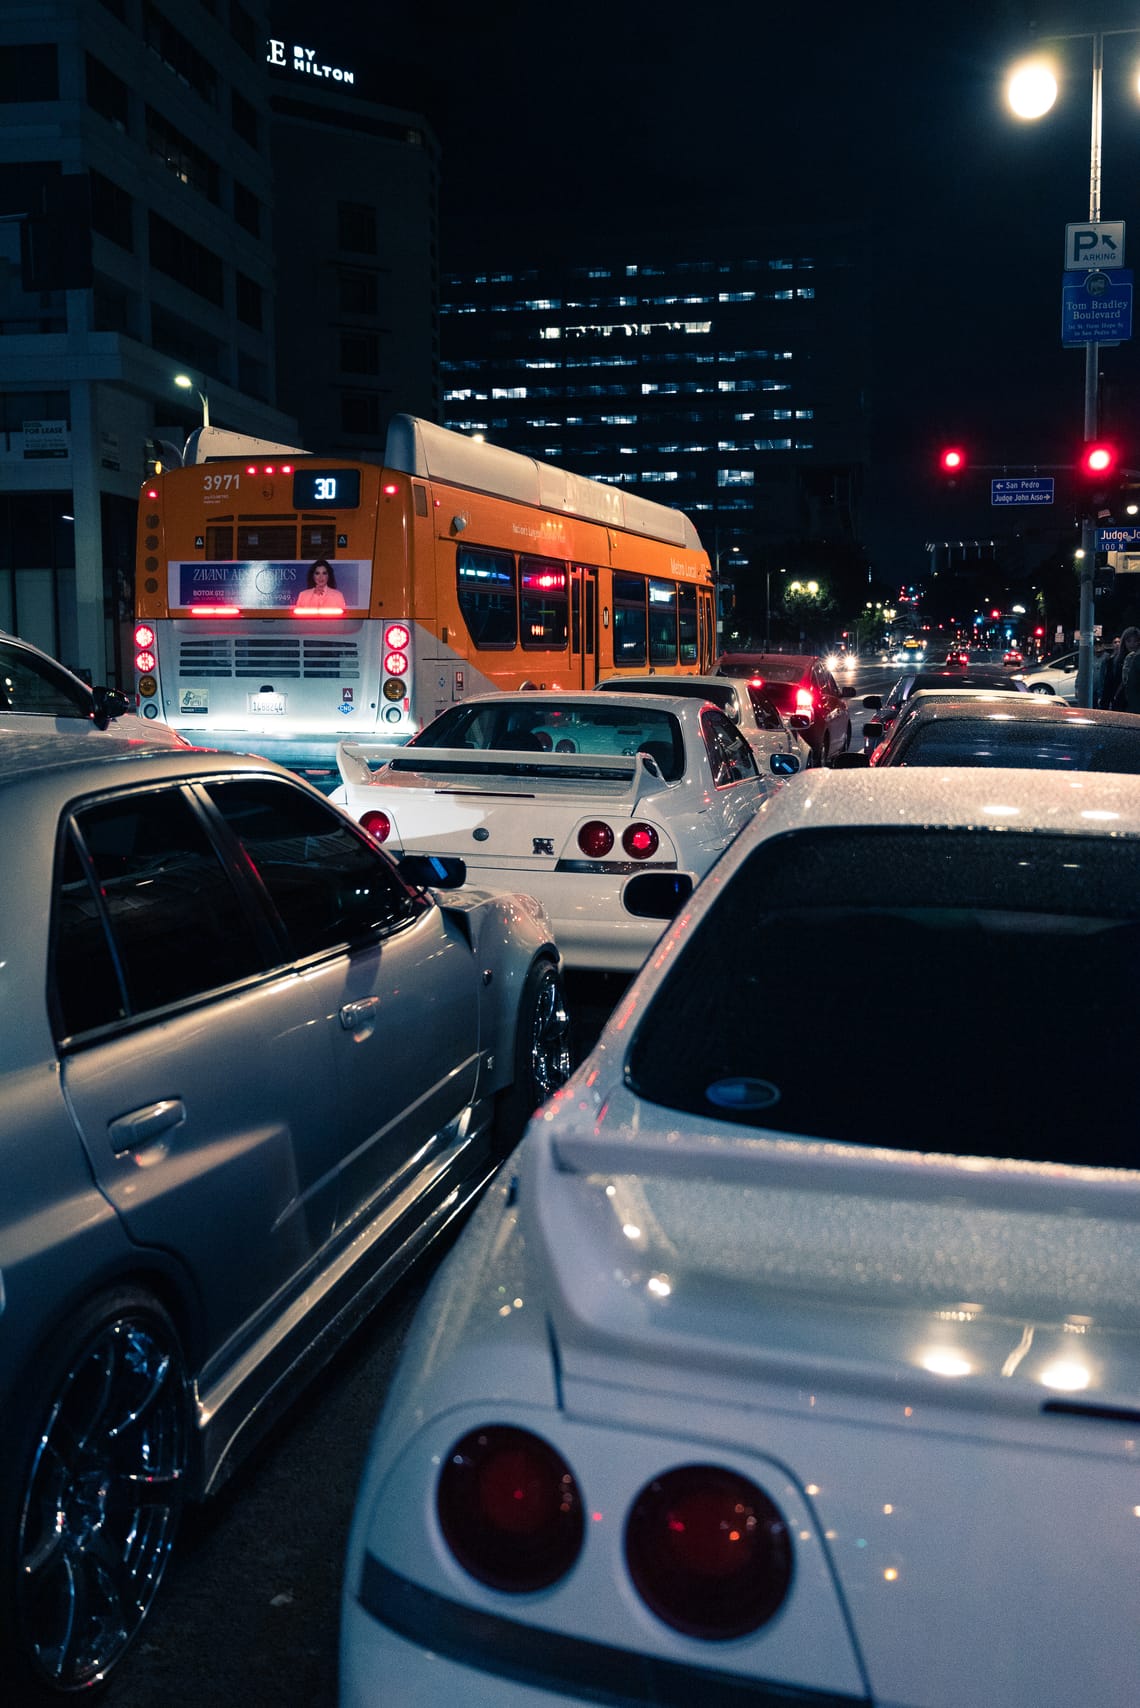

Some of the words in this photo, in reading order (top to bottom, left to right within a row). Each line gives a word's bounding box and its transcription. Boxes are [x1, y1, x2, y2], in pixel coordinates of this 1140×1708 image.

[267, 39, 287, 66] E
[293, 46, 315, 61] BY
[293, 58, 354, 84] HILTON
[1066, 302, 1087, 311] Tom
[1092, 299, 1129, 310] Bradley
[1073, 310, 1121, 320] Boulevard
[203, 473, 241, 491] 3971
[1005, 481, 1018, 489] San
[1021, 480, 1040, 489] Pedro
[314, 477, 336, 500] 30
[994, 494, 1013, 503] Judge
[1014, 493, 1029, 502] John
[1100, 530, 1129, 542] Judge
[1118, 543, 1125, 551] N
[670, 557, 685, 577] Metro
[685, 560, 697, 579] Local
[193, 568, 227, 581] ZAVANT
